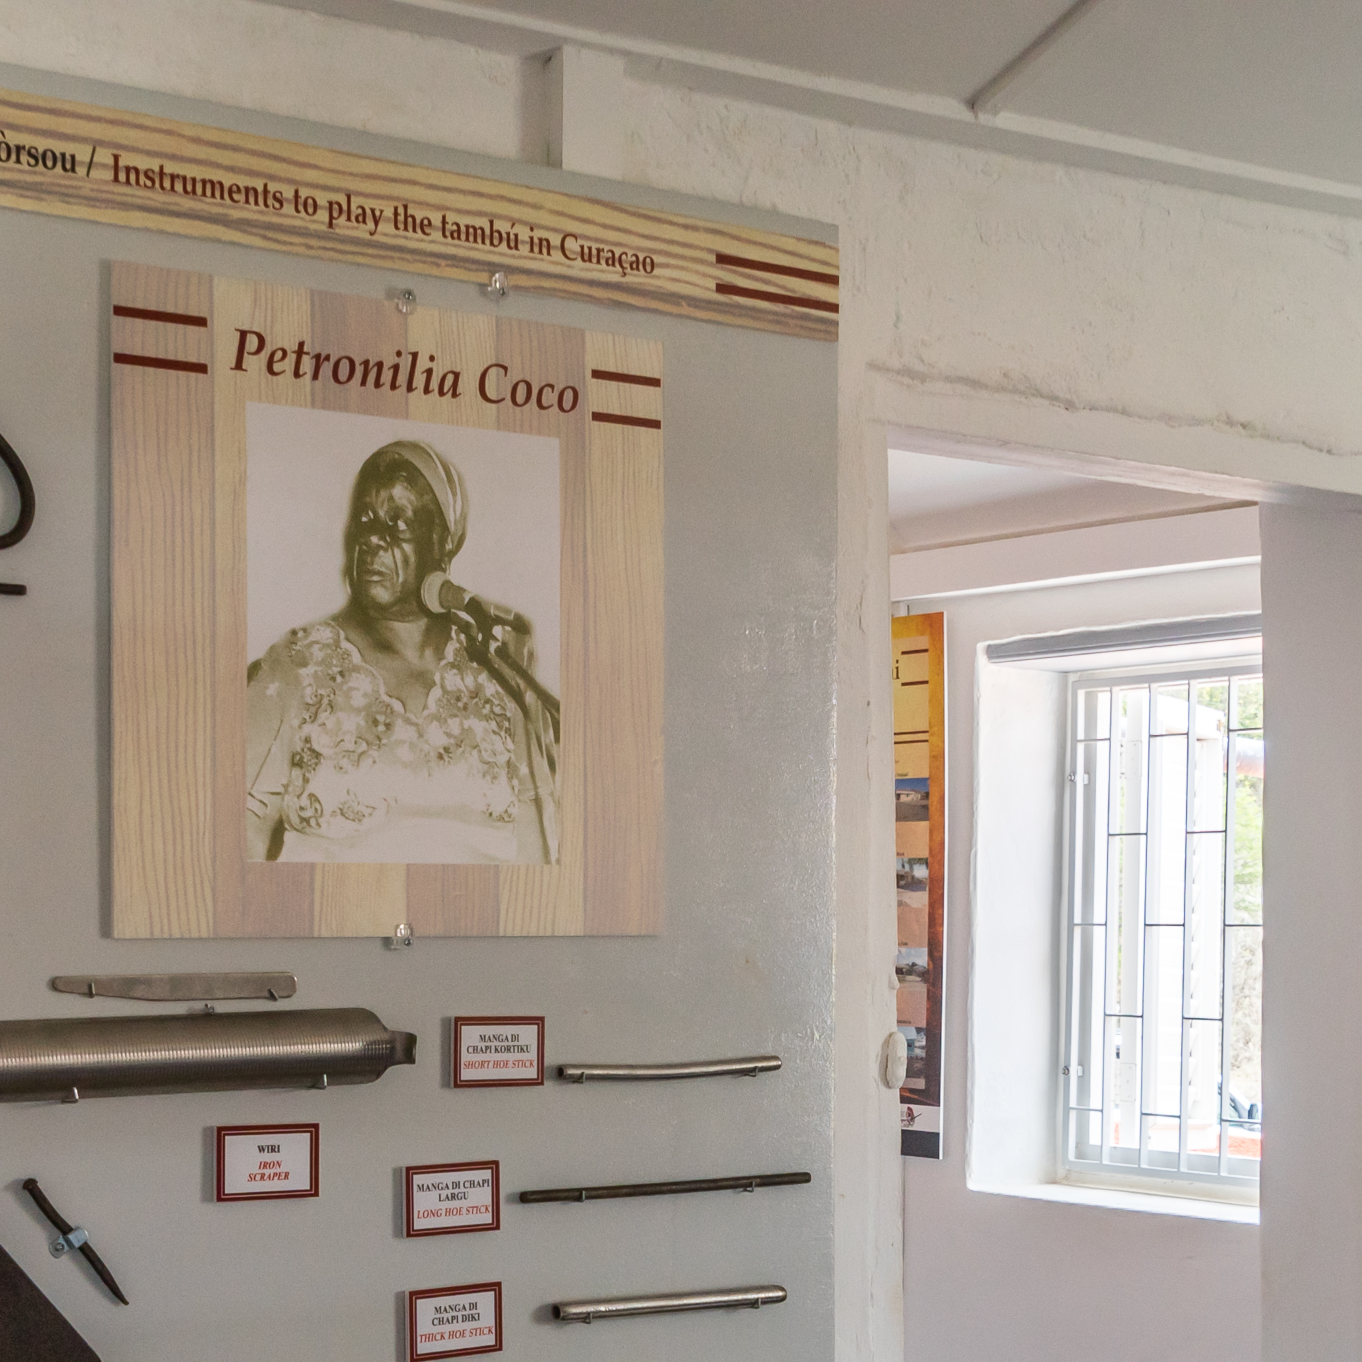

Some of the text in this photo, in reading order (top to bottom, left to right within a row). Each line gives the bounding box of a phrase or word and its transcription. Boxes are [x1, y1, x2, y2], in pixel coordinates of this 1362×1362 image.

[86, 146, 96, 177] /
[111, 153, 285, 211] Instruments
[292, 187, 318, 216] to
[326, 193, 384, 236] play
[393, 204, 432, 236] the
[441, 213, 520, 251] tambú
[528, 226, 552, 256] in
[560, 233, 655, 277] Curaçao
[230, 328, 579, 413] Petronilia Coco
[479, 1034, 519, 1043] MANGA DI
[467, 1045, 531, 1054] CHAPI KORTIKU
[463, 1059, 535, 1069] SHORT HOE STICK
[257, 1145, 280, 1153] WIRI
[258, 1161, 282, 1170] IRON
[247, 1172, 290, 1182] SCRAPER
[417, 1179, 490, 1192] MANGA DI CHAPI
[438, 1191, 469, 1202] LARGU
[417, 1205, 491, 1219] LONG HOE STICK
[434, 1302, 477, 1315] MANGA DI
[432, 1313, 480, 1326] CHAPI DIKI
[419, 1326, 494, 1343] THICK HOE STICK
